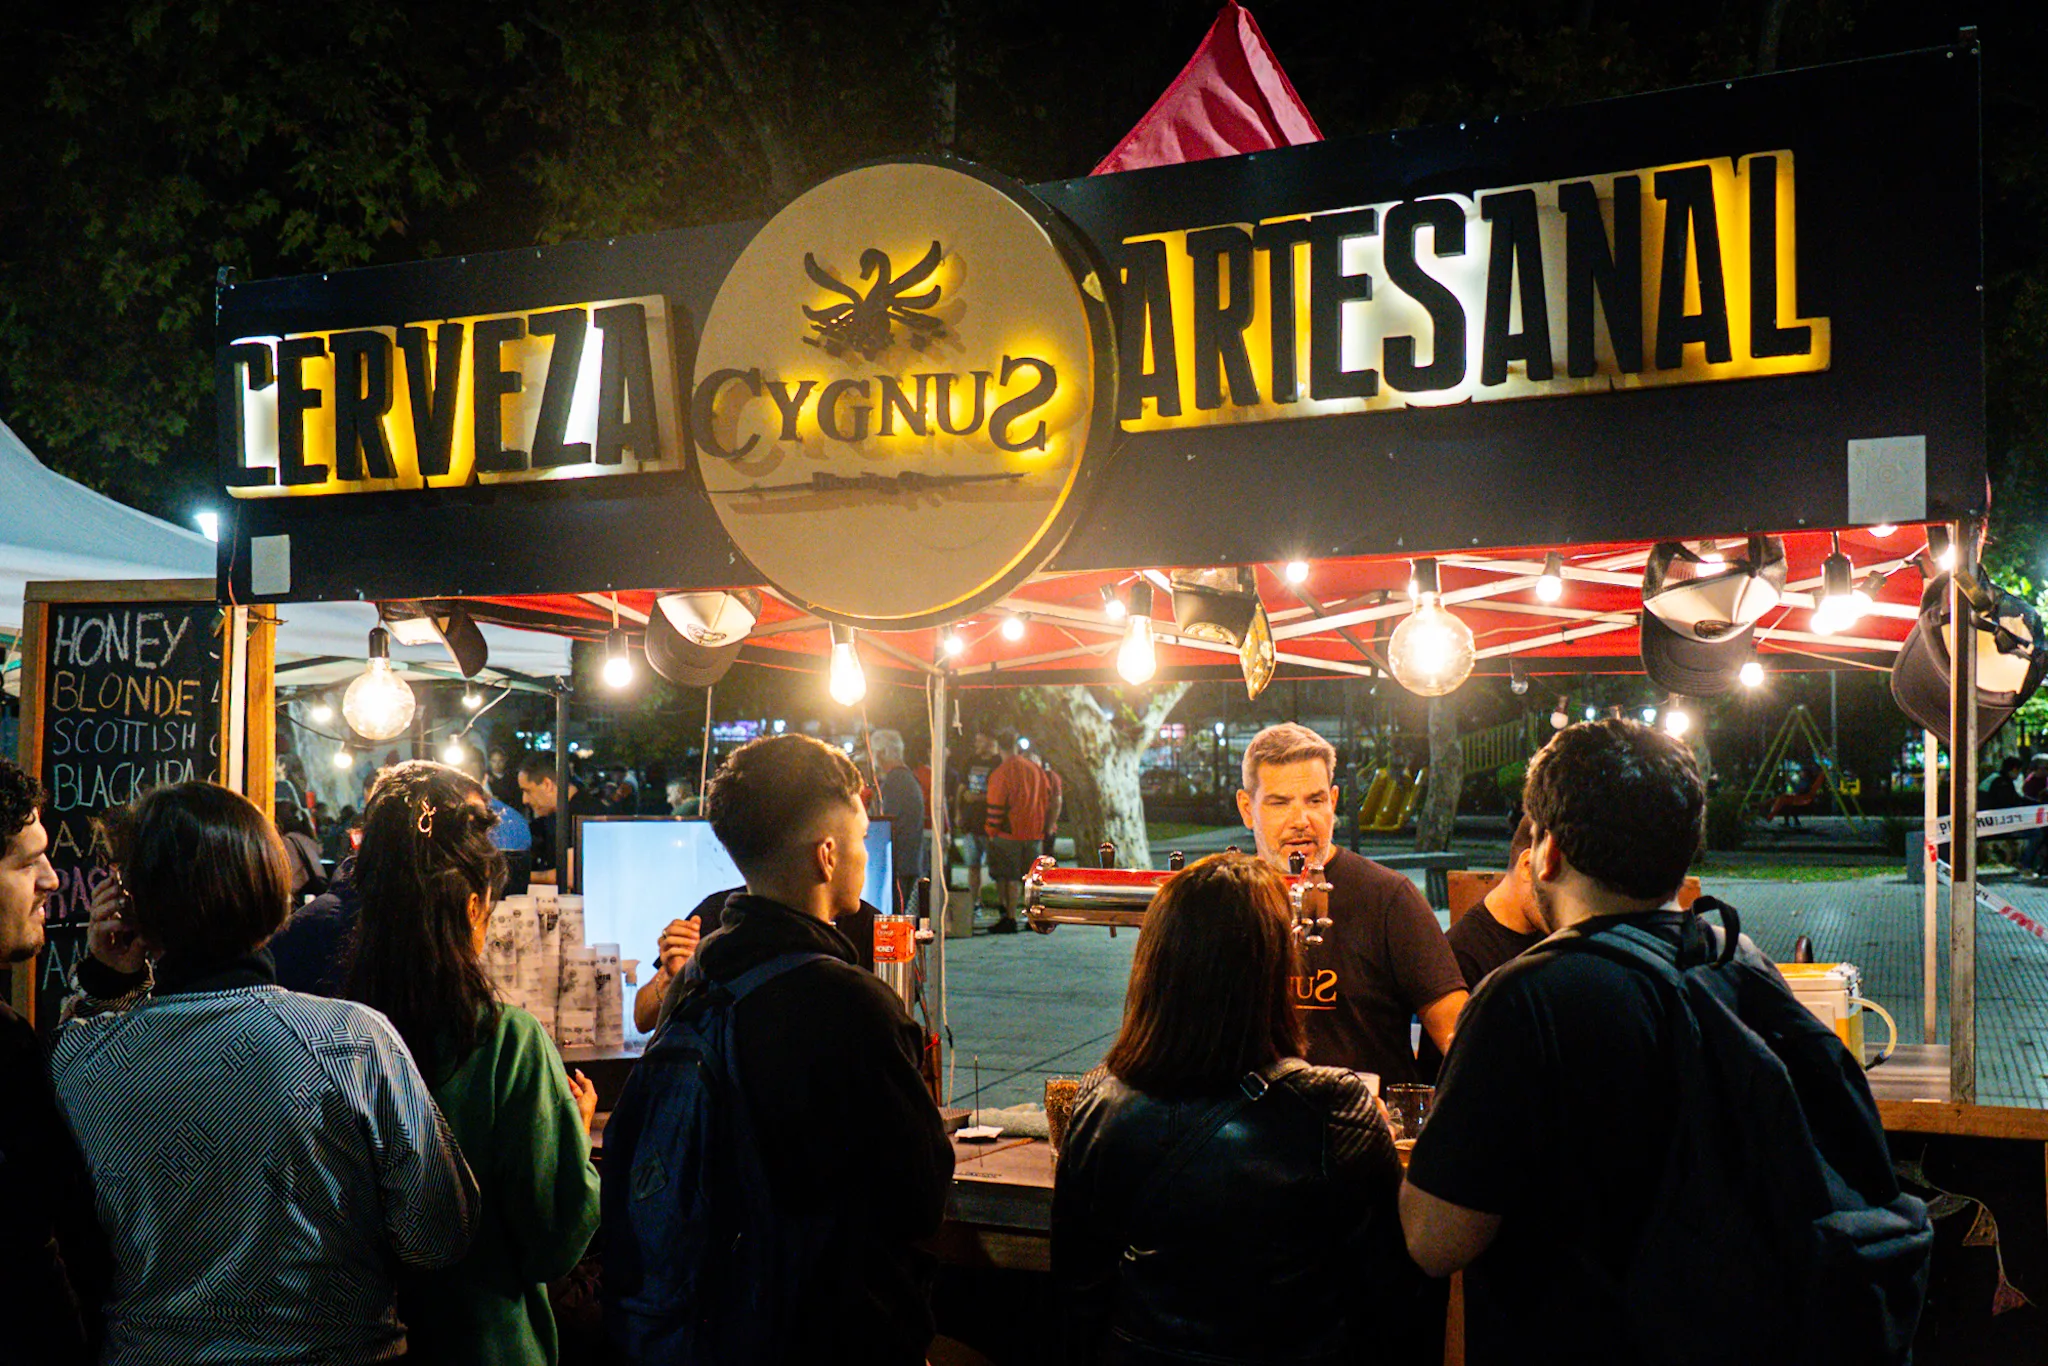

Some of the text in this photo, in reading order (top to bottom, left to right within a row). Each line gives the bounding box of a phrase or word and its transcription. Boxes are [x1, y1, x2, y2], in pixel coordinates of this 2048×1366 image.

[1120, 155, 1812, 420] ARTESANAL
[222, 302, 662, 487] CERVEZA
[691, 355, 1057, 459] CYGNUS
[54, 611, 189, 669] HONEY
[53, 670, 200, 718] BLONDE
[53, 717, 197, 756] SCOTTISH
[54, 762, 145, 811] BLACK
